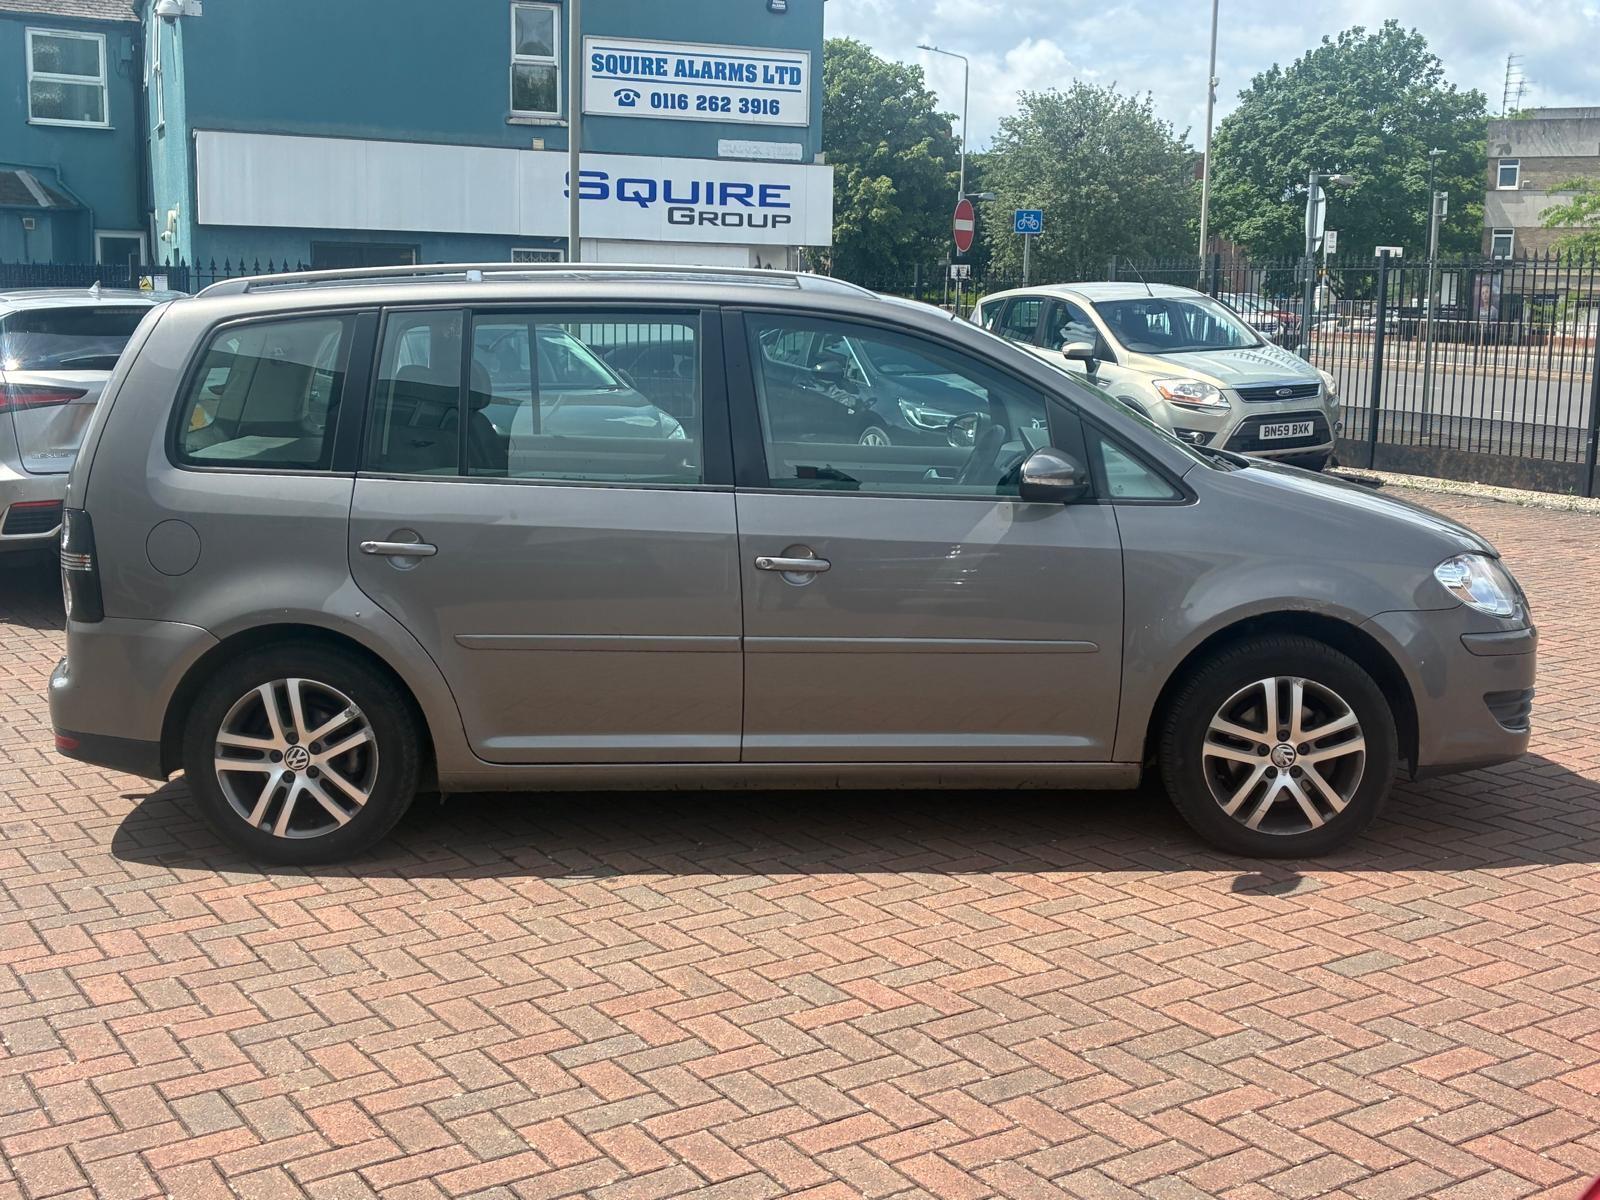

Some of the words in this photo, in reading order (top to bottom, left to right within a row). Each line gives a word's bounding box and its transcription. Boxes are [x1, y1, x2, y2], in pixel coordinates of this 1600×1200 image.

[591, 53, 668, 76] SQUIRE
[674, 58, 758, 83] ALARMS
[763, 64, 802, 86] LTD
[650, 91, 689, 110] 0116
[696, 95, 732, 112] 262
[738, 97, 780, 115] 3916
[563, 170, 791, 208] SQUIRE
[667, 206, 792, 229] GROUP
[1264, 425, 1289, 437] BN59
[1292, 424, 1309, 434] BXK
